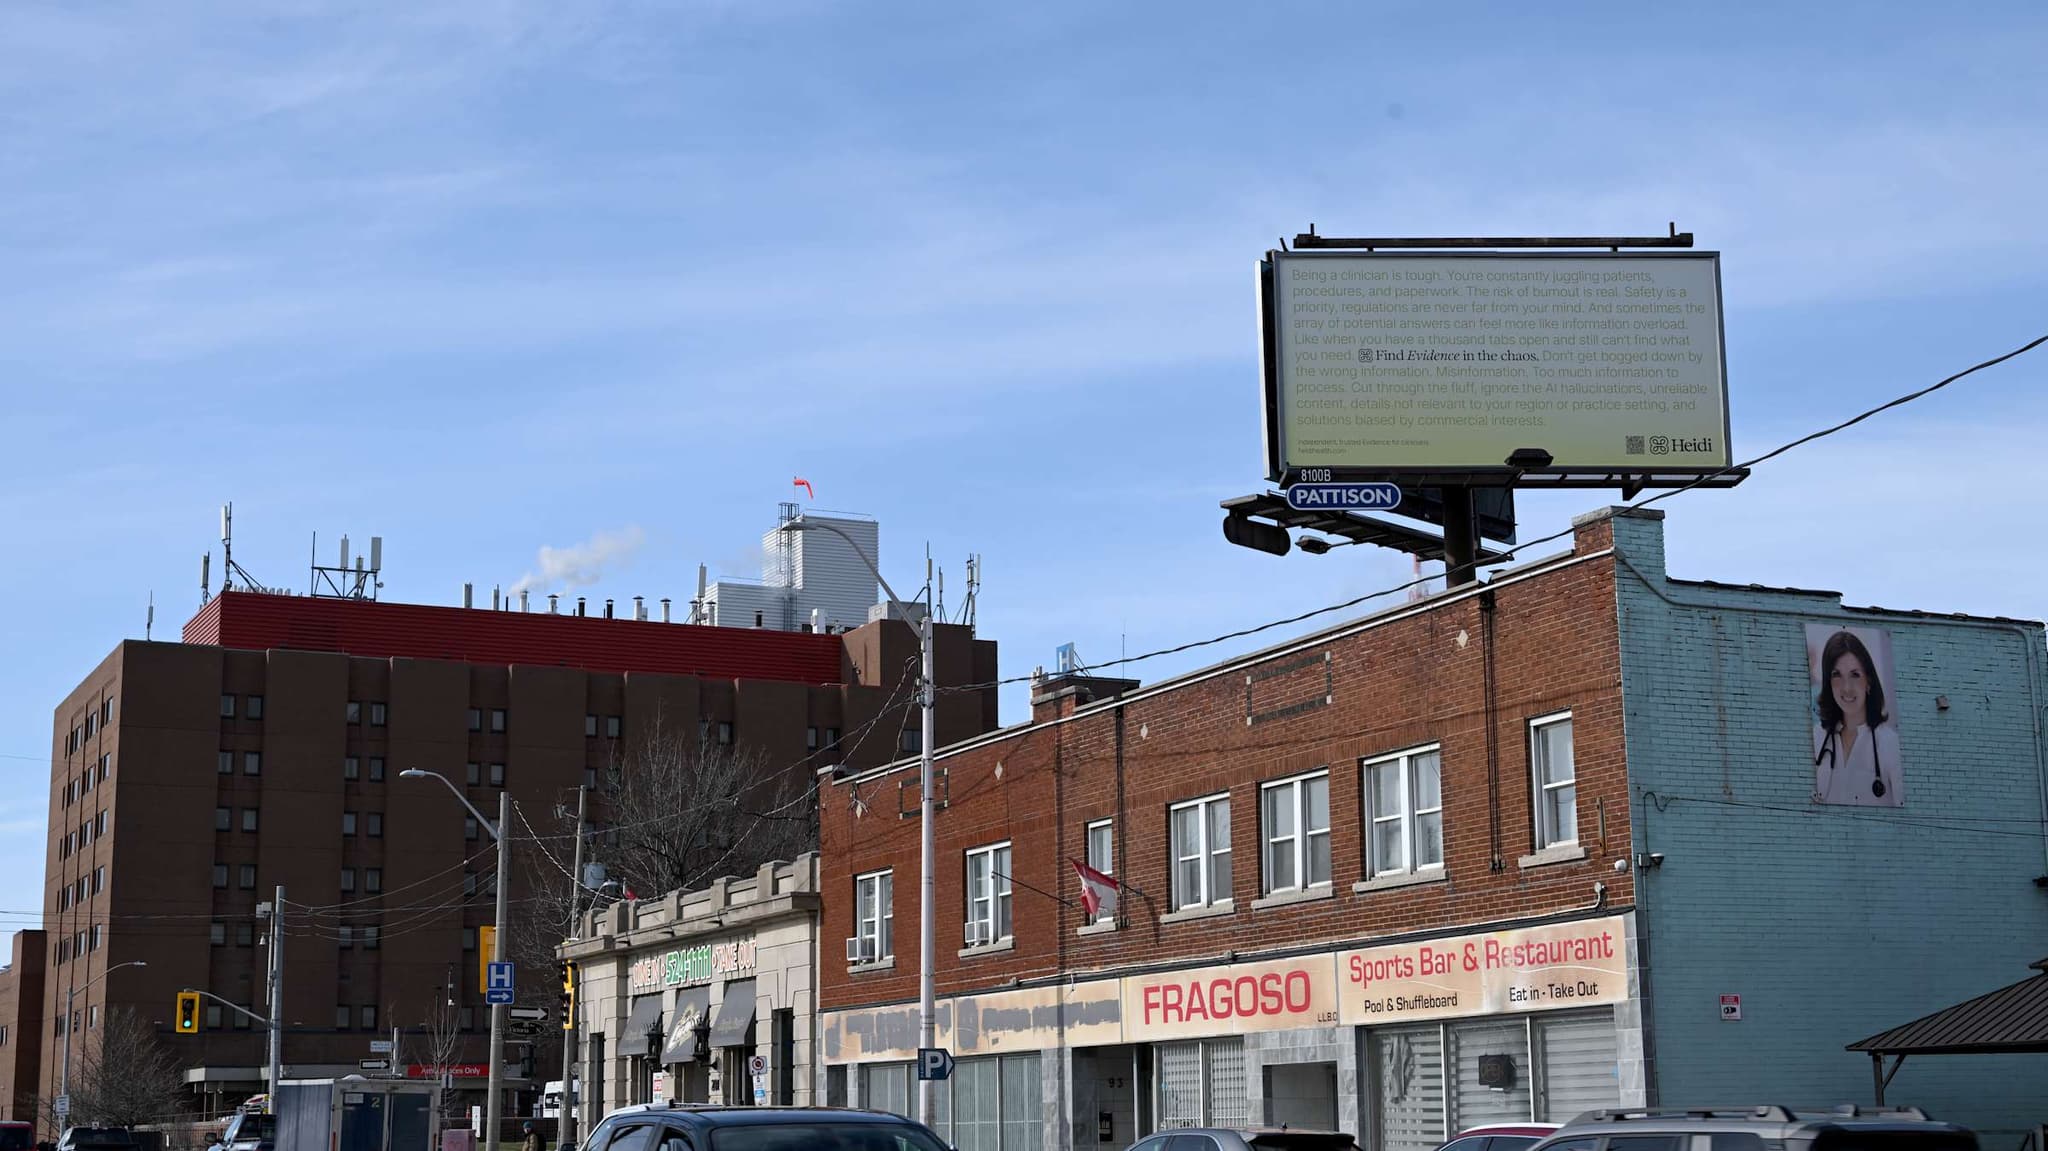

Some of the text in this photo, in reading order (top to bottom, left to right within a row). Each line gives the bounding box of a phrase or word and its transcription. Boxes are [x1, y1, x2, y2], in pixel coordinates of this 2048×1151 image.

[1292, 270, 1327, 283] Being
[1329, 272, 1338, 280] a
[1340, 270, 1389, 280] clinician
[1392, 270, 1403, 281] is
[1447, 270, 1484, 281] You're
[1486, 271, 1550, 284] constantly
[1551, 271, 1600, 284] juggling
[1369, 286, 1391, 297] and
[1466, 286, 1490, 297] The
[1492, 287, 1515, 297] risk
[1517, 287, 1530, 297] of
[1532, 287, 1580, 297] burnout
[1583, 287, 1593, 297] is
[1624, 287, 1664, 300] Safety
[1666, 287, 1676, 297] is
[1679, 289, 1688, 297] a
[1341, 302, 1409, 315] regulations
[1412, 305, 1432, 313] are
[1434, 305, 1468, 313] never
[1471, 303, 1489, 313] far
[1491, 303, 1519, 313] from
[1522, 305, 1550, 316] your
[1589, 303, 1613, 313] And
[1616, 303, 1683, 313] sometimes
[1686, 303, 1706, 313] the
[1293, 320, 1325, 331] array
[1328, 318, 1341, 328] of
[1344, 318, 1396, 331] potential
[1399, 321, 1451, 329] answers
[1453, 321, 1477, 329] can
[1479, 319, 1503, 329] feel
[1505, 321, 1535, 329] more
[1538, 319, 1559, 329] like
[1562, 319, 1630, 329] information
[1294, 334, 1691, 348] Like when you have a thousand tabs open and still can't find what
[1295, 352, 1317, 363] you
[1375, 350, 1405, 361] Find
[1407, 350, 1461, 361] Evidence
[1462, 351, 1476, 361] in
[1477, 351, 1499, 361] the
[1500, 351, 1540, 361] chaos.
[1543, 351, 1575, 361] Don't
[1577, 351, 1599, 364] get
[1601, 351, 1649, 364] bogged
[1651, 351, 1685, 361] down
[1688, 351, 1704, 364] by
[1295, 366, 1317, 376] the
[1319, 368, 1358, 379] wrong
[1533, 367, 1555, 377] Too
[1557, 367, 1592, 377] much
[1594, 367, 1664, 377] information
[1666, 367, 1680, 377] to
[1351, 382, 1373, 393] Cut
[1376, 382, 1424, 396] through
[1427, 383, 1448, 393] the
[1480, 383, 1519, 396] ignore
[1521, 383, 1542, 393] the
[1545, 383, 1558, 393] AI
[1650, 383, 1708, 393] unreliable
[1350, 398, 1391, 409] details
[1393, 398, 1413, 409] not
[1417, 399, 1466, 409] relevant
[1469, 399, 1483, 409] to
[1485, 401, 1512, 412] your
[1514, 399, 1554, 412] region
[1556, 401, 1569, 409] or
[1572, 399, 1621, 412] practice
[1672, 399, 1697, 409] and
[1296, 414, 1352, 425] solutions
[1355, 414, 1396, 425] biased
[1399, 414, 1415, 428] by
[1418, 415, 1488, 425] commercial
[1671, 437, 1713, 453] Heidi
[1301, 469, 1331, 482] 8100B
[1296, 489, 1392, 504] PATTISON
[665, 945, 712, 985] 524-1111
[716, 944, 738, 973] TAKE
[738, 939, 757, 969] OUT
[1350, 931, 1614, 989] Sports Bar & Restaurant
[490, 965, 511, 987] H
[1144, 970, 1311, 1025] FRAGOSO
[1509, 985, 1528, 1002] Eat
[1530, 986, 1540, 1000] in
[1548, 982, 1574, 999] Take
[1577, 980, 1599, 997] Out
[1364, 992, 1458, 1014] Pool & Shuffleboard
[464, 1066, 481, 1076] Only
[925, 1052, 944, 1078] P
[1109, 1078, 1124, 1089] 93
[371, 1097, 381, 1109] 2
